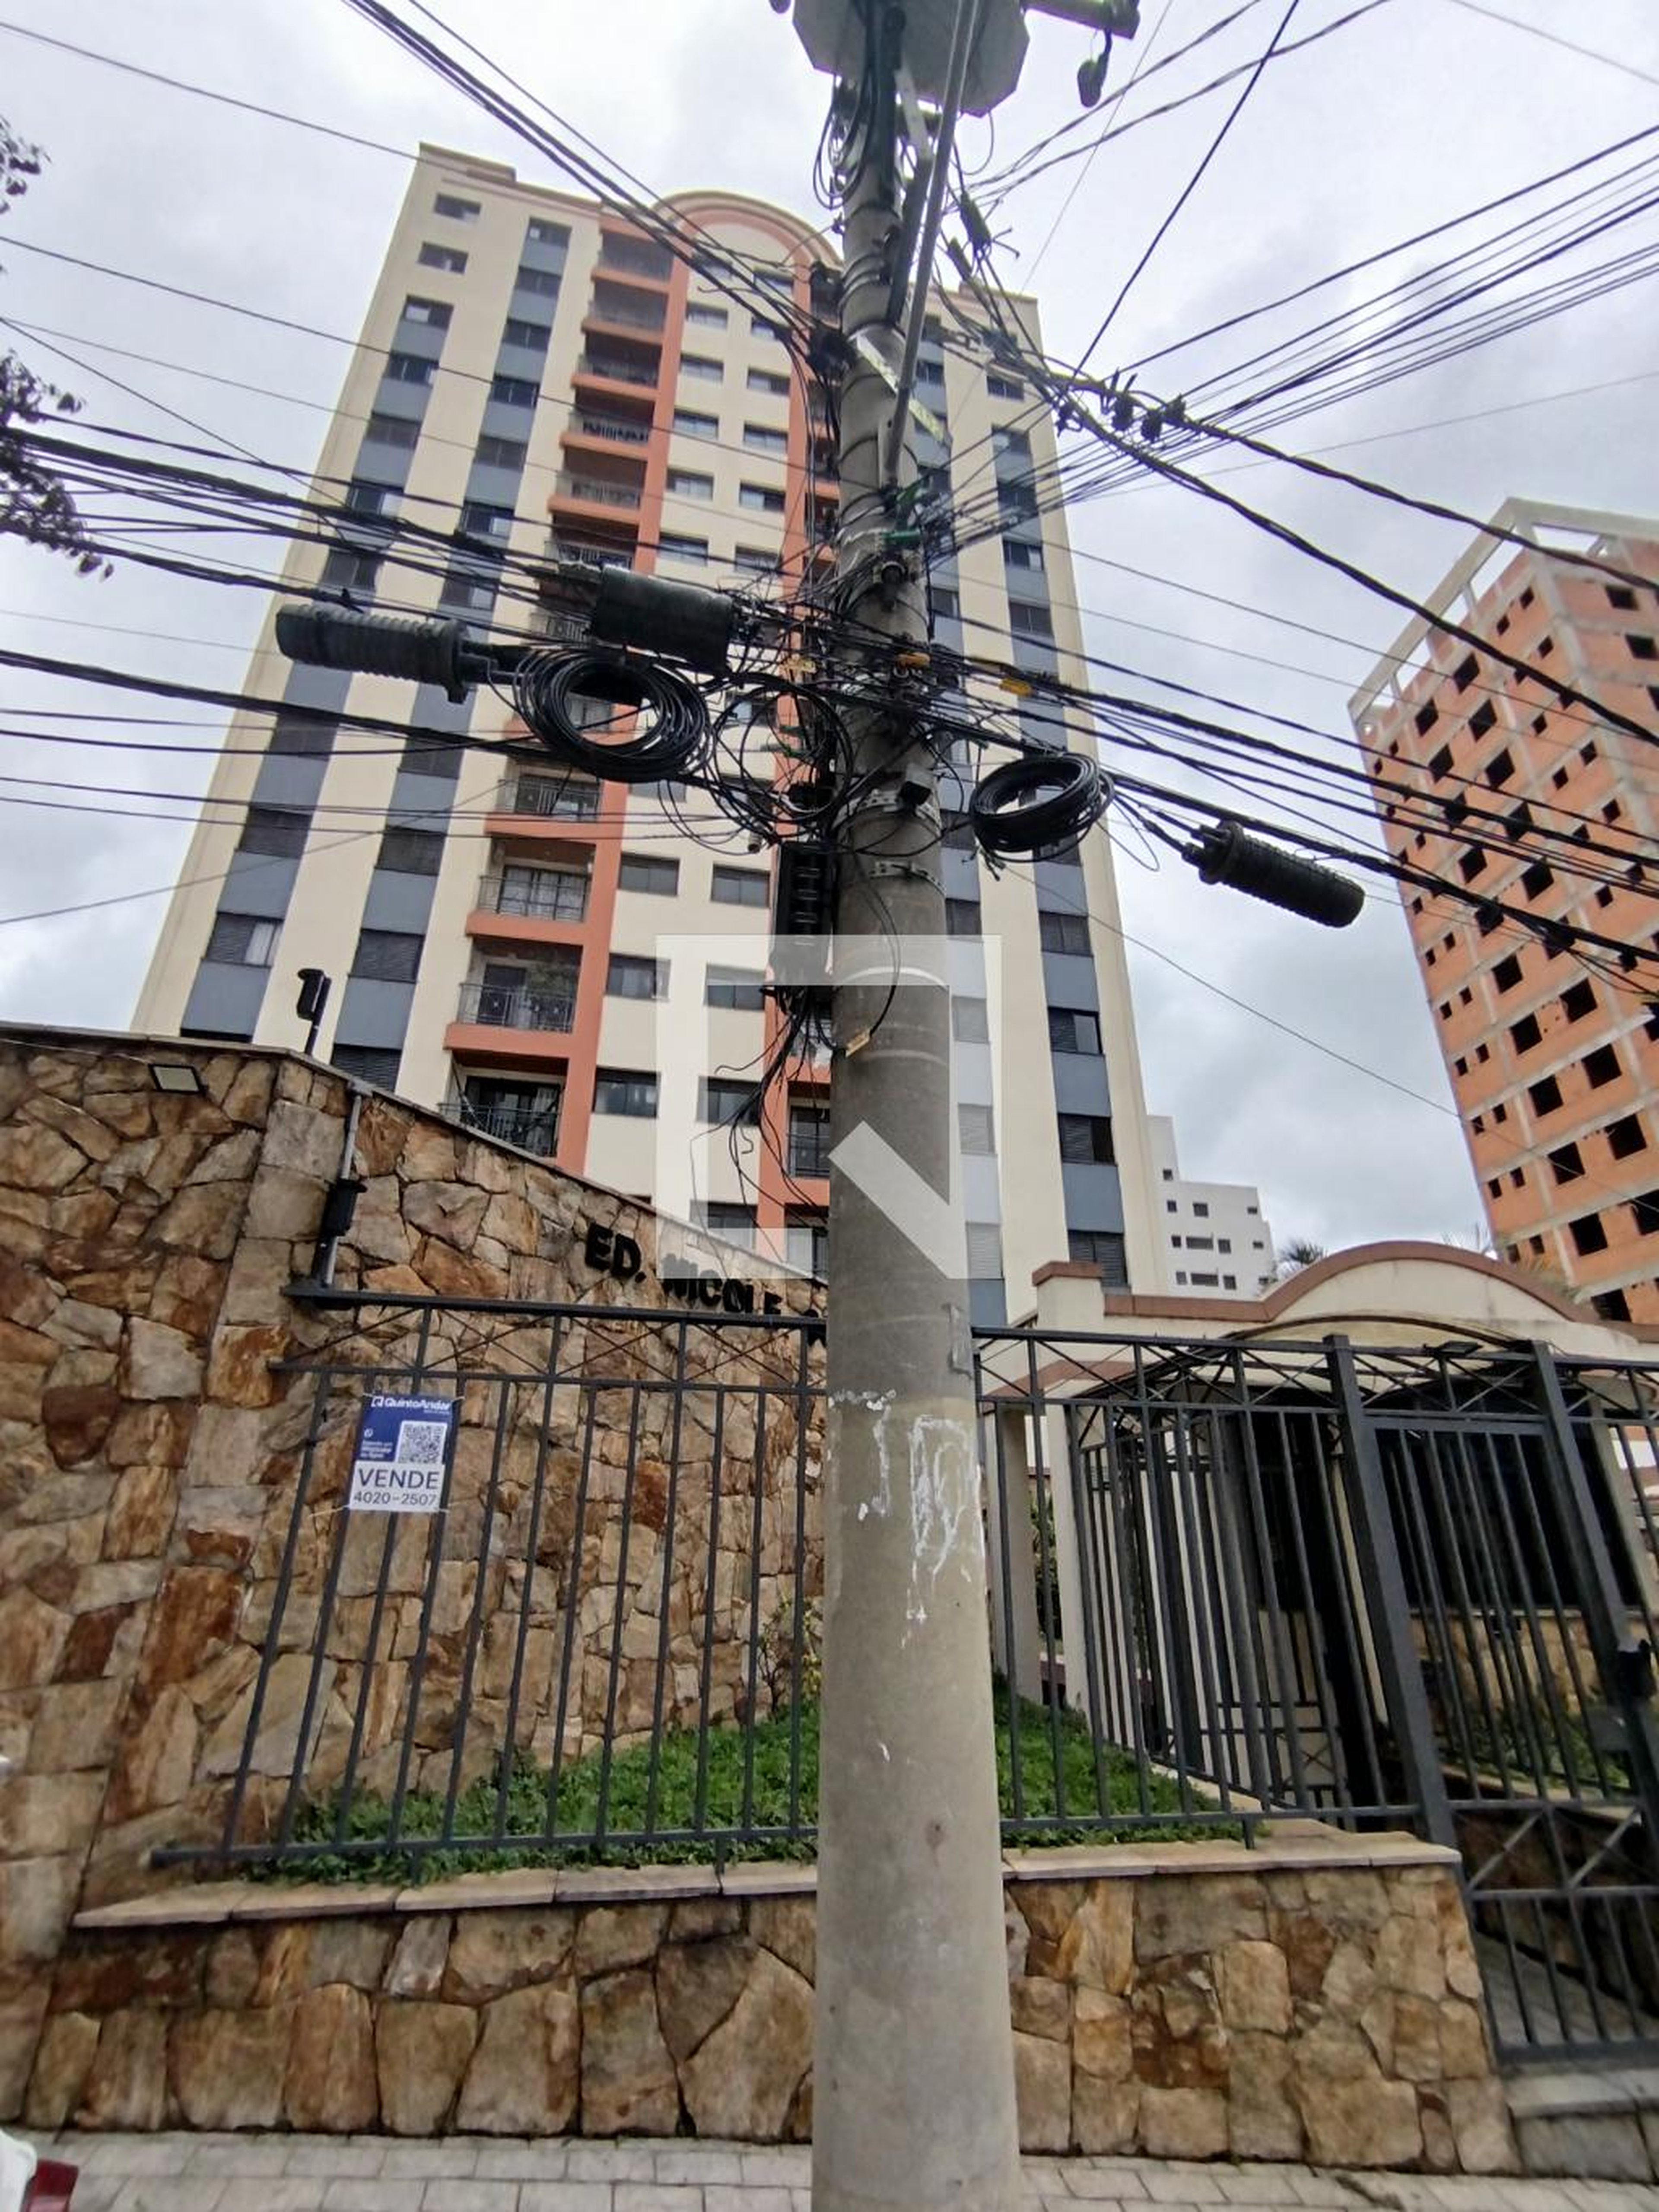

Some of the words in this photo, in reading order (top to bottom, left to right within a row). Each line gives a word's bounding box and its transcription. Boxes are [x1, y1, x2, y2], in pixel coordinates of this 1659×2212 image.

[585, 1221, 646, 1283] ED.
[358, 1468, 439, 1490] VENDE
[354, 1492, 436, 1506] 4020-2507
